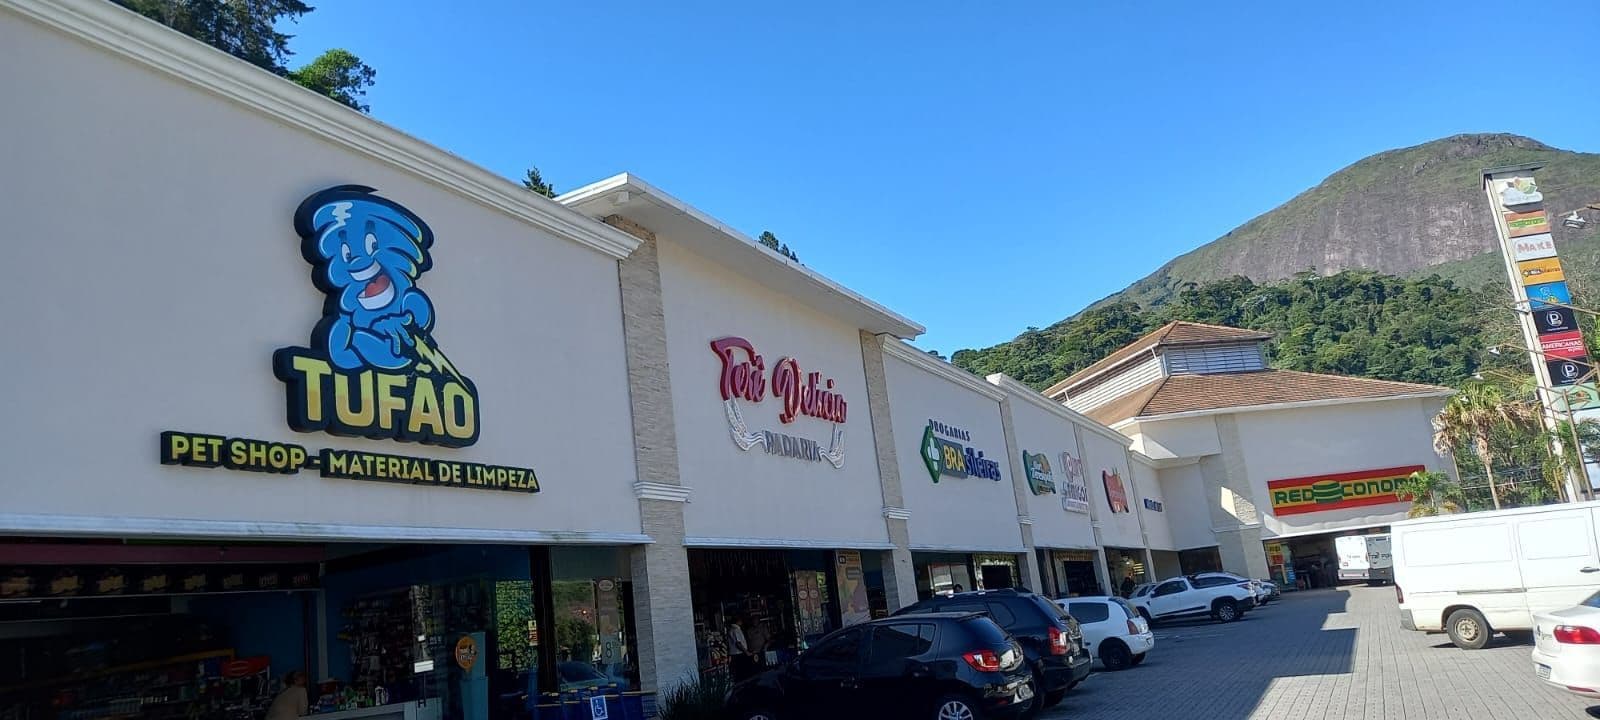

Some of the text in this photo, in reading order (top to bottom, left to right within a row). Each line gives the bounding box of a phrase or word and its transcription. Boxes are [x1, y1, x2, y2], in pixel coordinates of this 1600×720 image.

[292, 355, 475, 440] TUFÃO
[761, 430, 823, 462] PADARIA
[928, 419, 971, 442] DROGARIAS
[171, 435, 223, 464] PET
[230, 441, 306, 470] SHOP
[329, 452, 433, 482] MATERIAL
[438, 463, 461, 483] DE
[466, 465, 538, 490] LIMPEZA
